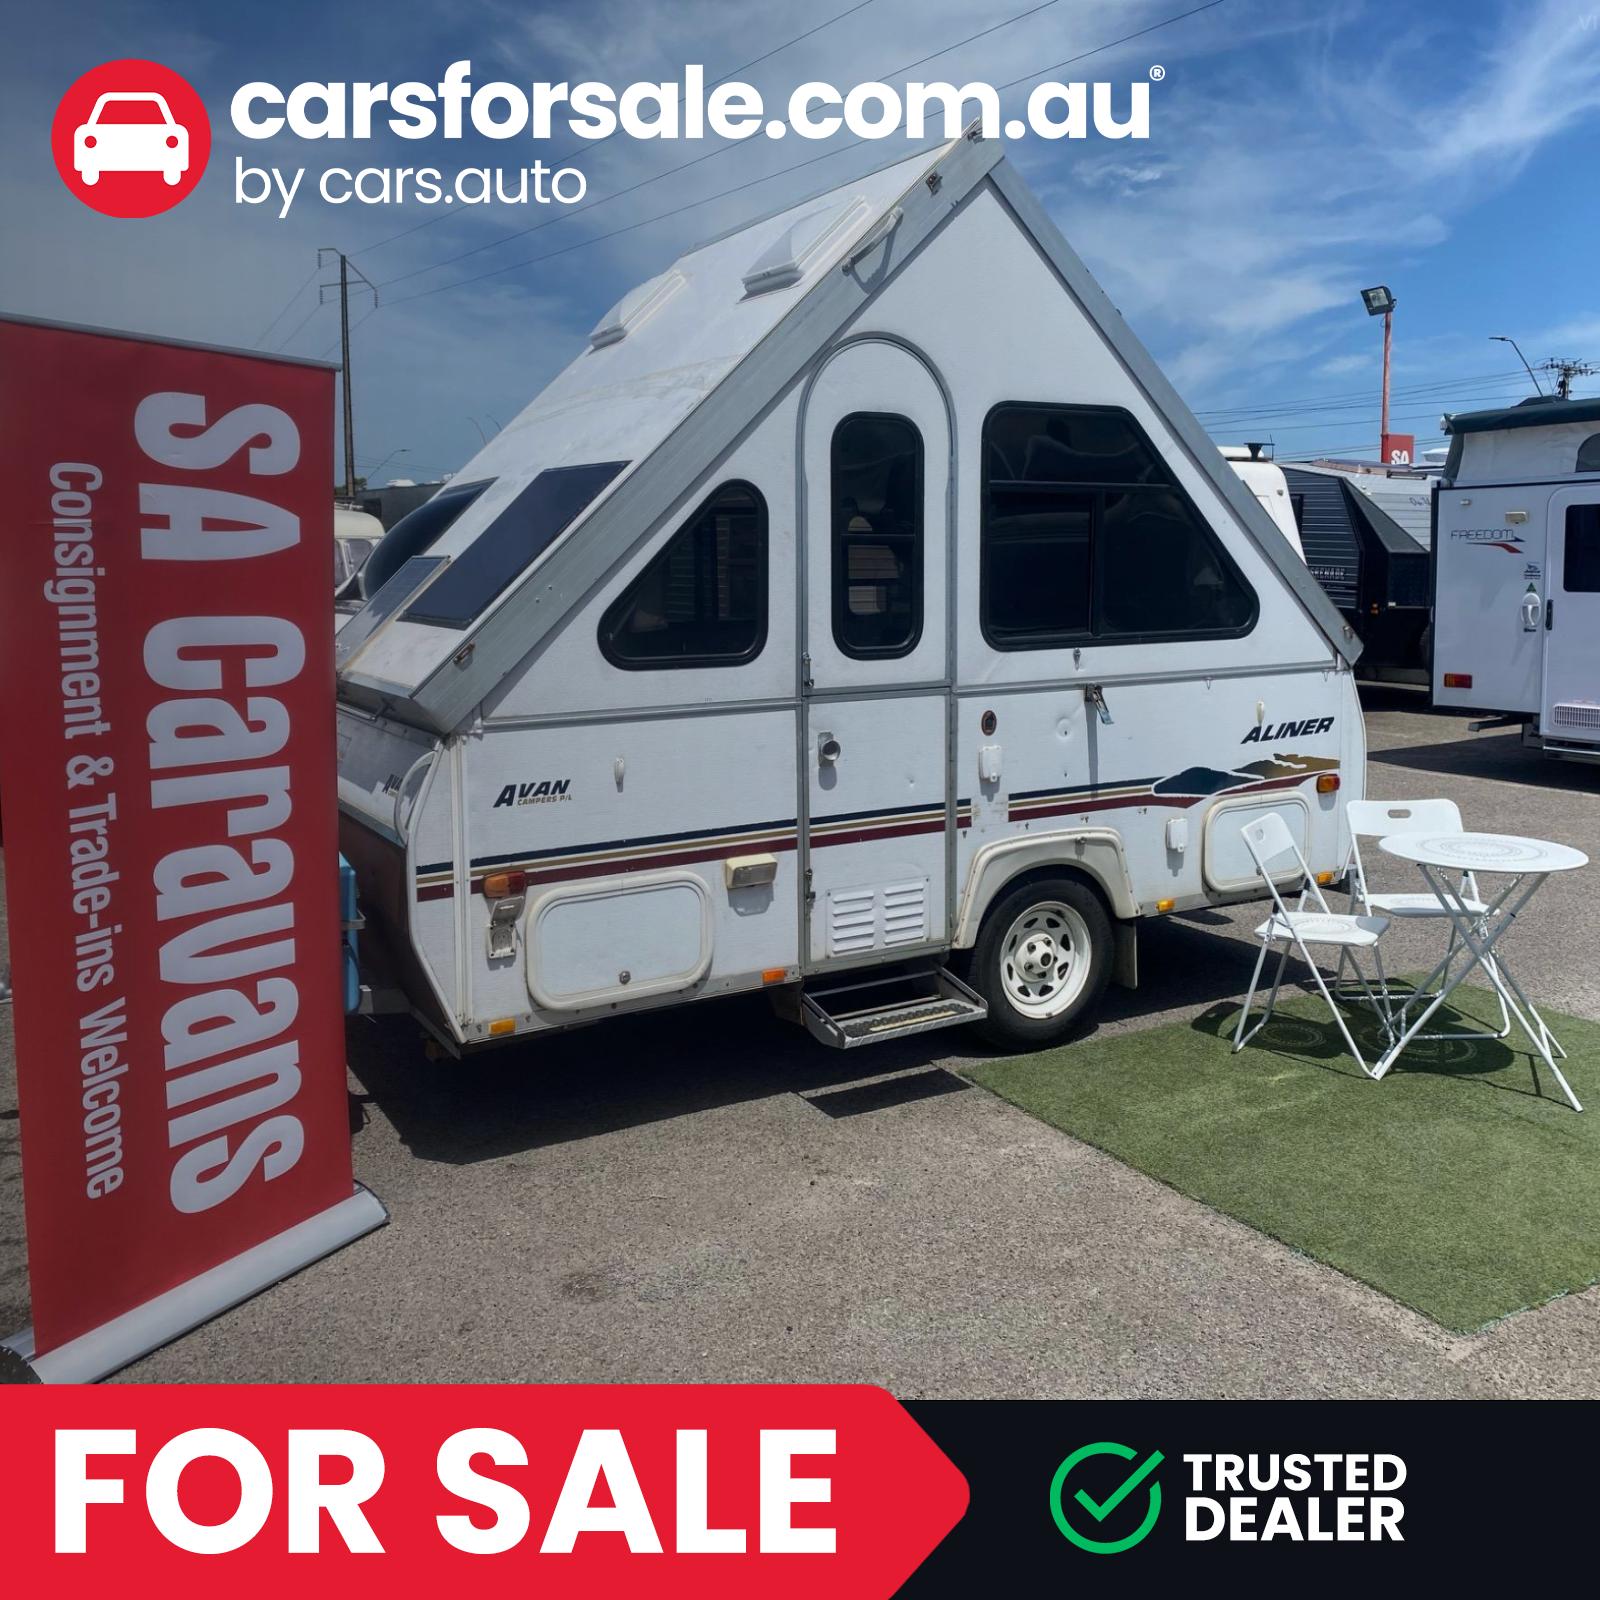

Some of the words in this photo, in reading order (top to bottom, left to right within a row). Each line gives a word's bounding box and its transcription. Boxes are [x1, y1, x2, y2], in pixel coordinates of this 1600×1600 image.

[1391, 450, 1410, 465] SA
[134, 391, 301, 562] SA
[1450, 529, 1514, 541] FREEDOM
[43, 462, 112, 740] Consignment
[1240, 716, 1335, 745] ALINER
[65, 754, 115, 790] &
[493, 779, 571, 808] AVAN
[517, 794, 557, 806] CAMPERS
[68, 792, 122, 993] Trade-ins
[143, 615, 305, 1214] Caravans
[79, 996, 129, 1200] Welcome
